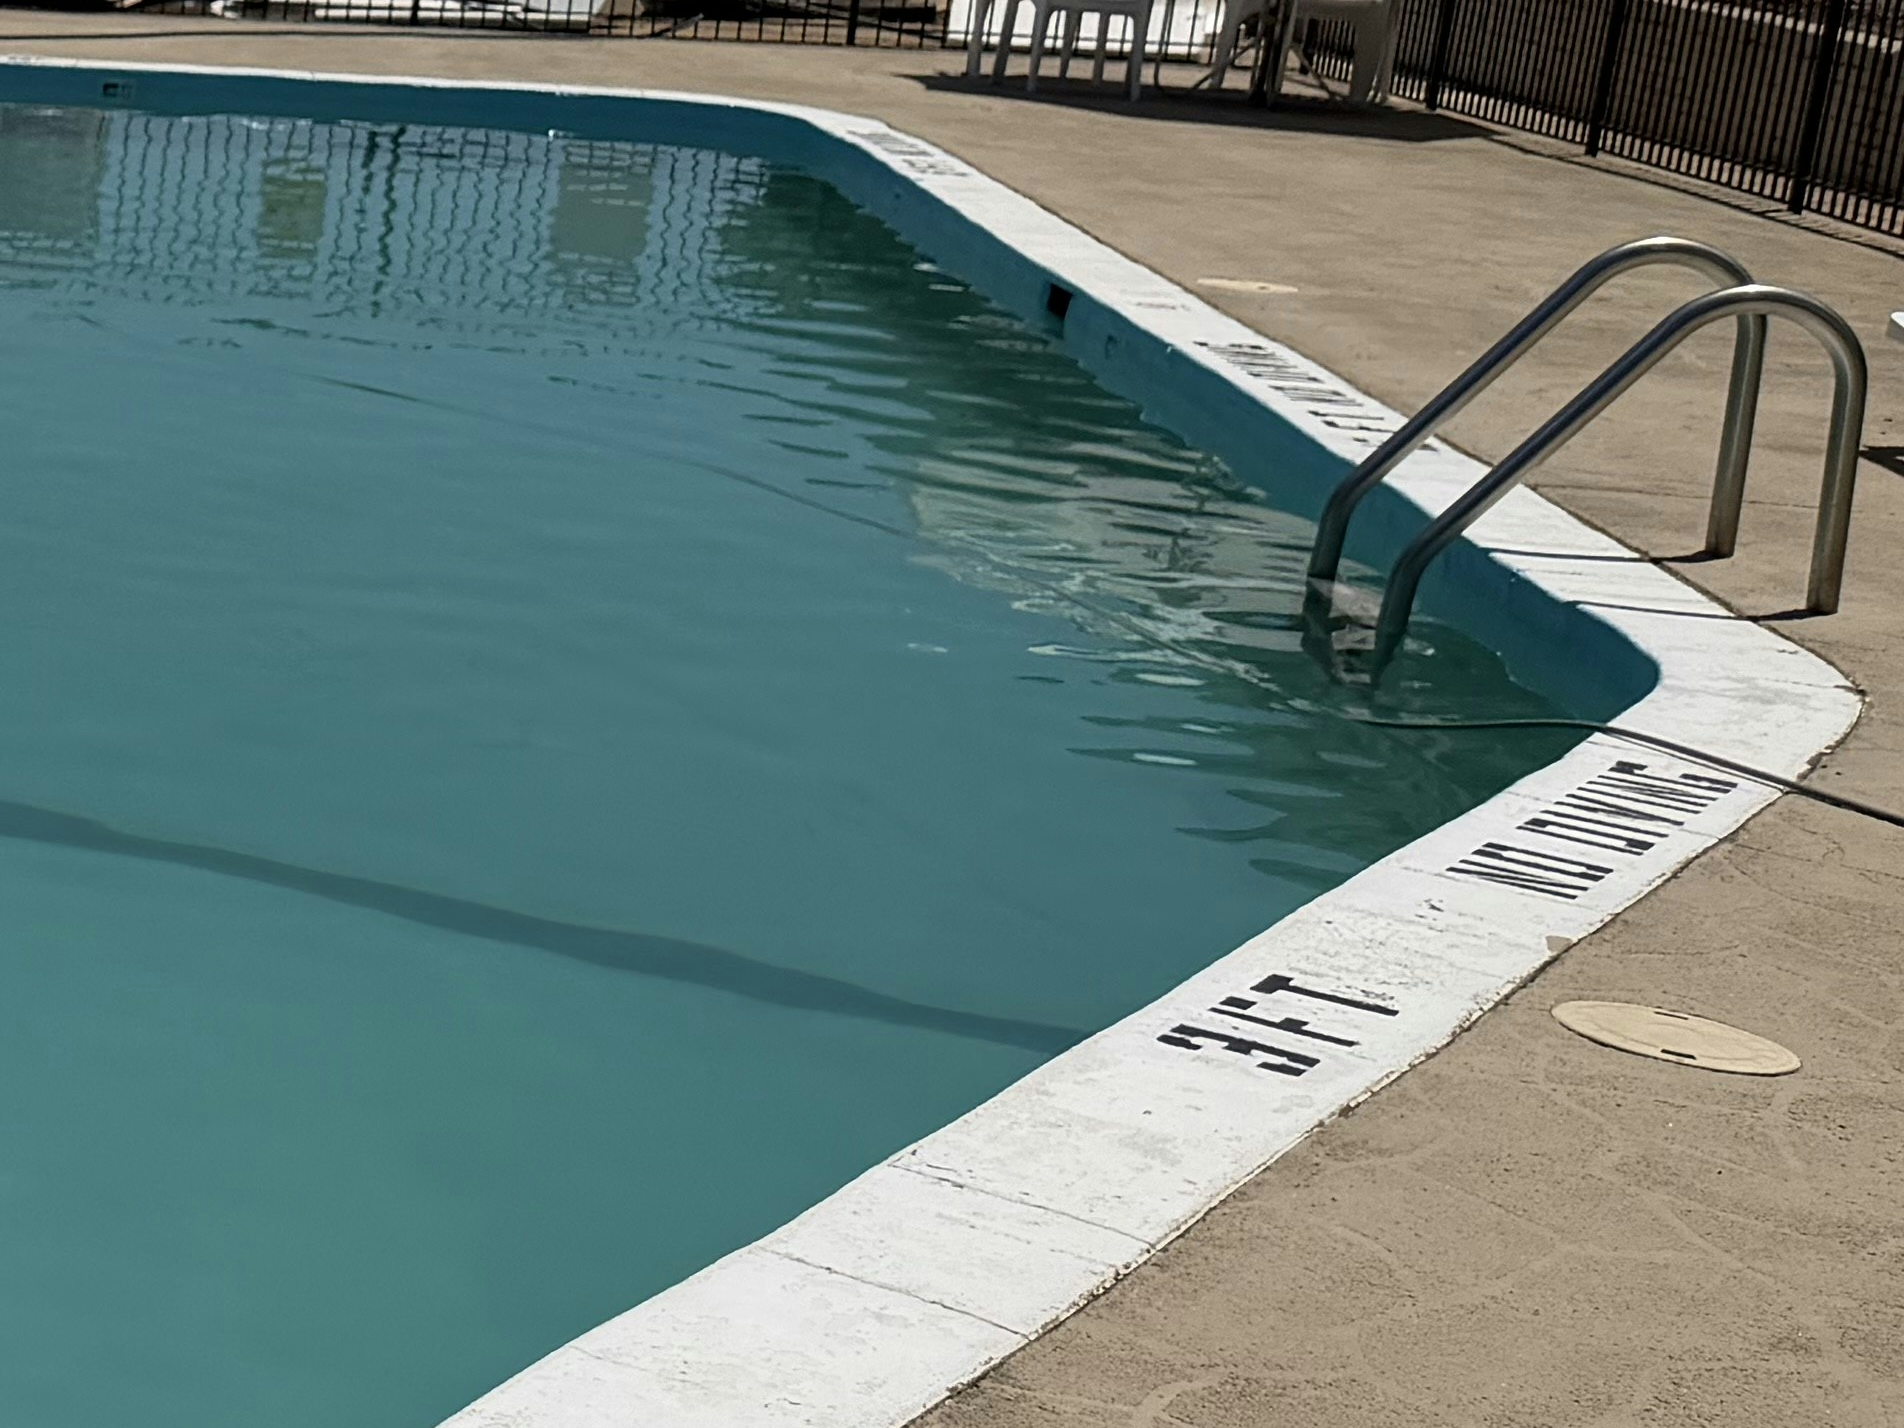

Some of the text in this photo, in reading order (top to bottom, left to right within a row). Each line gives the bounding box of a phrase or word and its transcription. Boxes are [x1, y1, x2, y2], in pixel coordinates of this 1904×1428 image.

[1156, 759, 1739, 1077] 3FT NO DIVING
